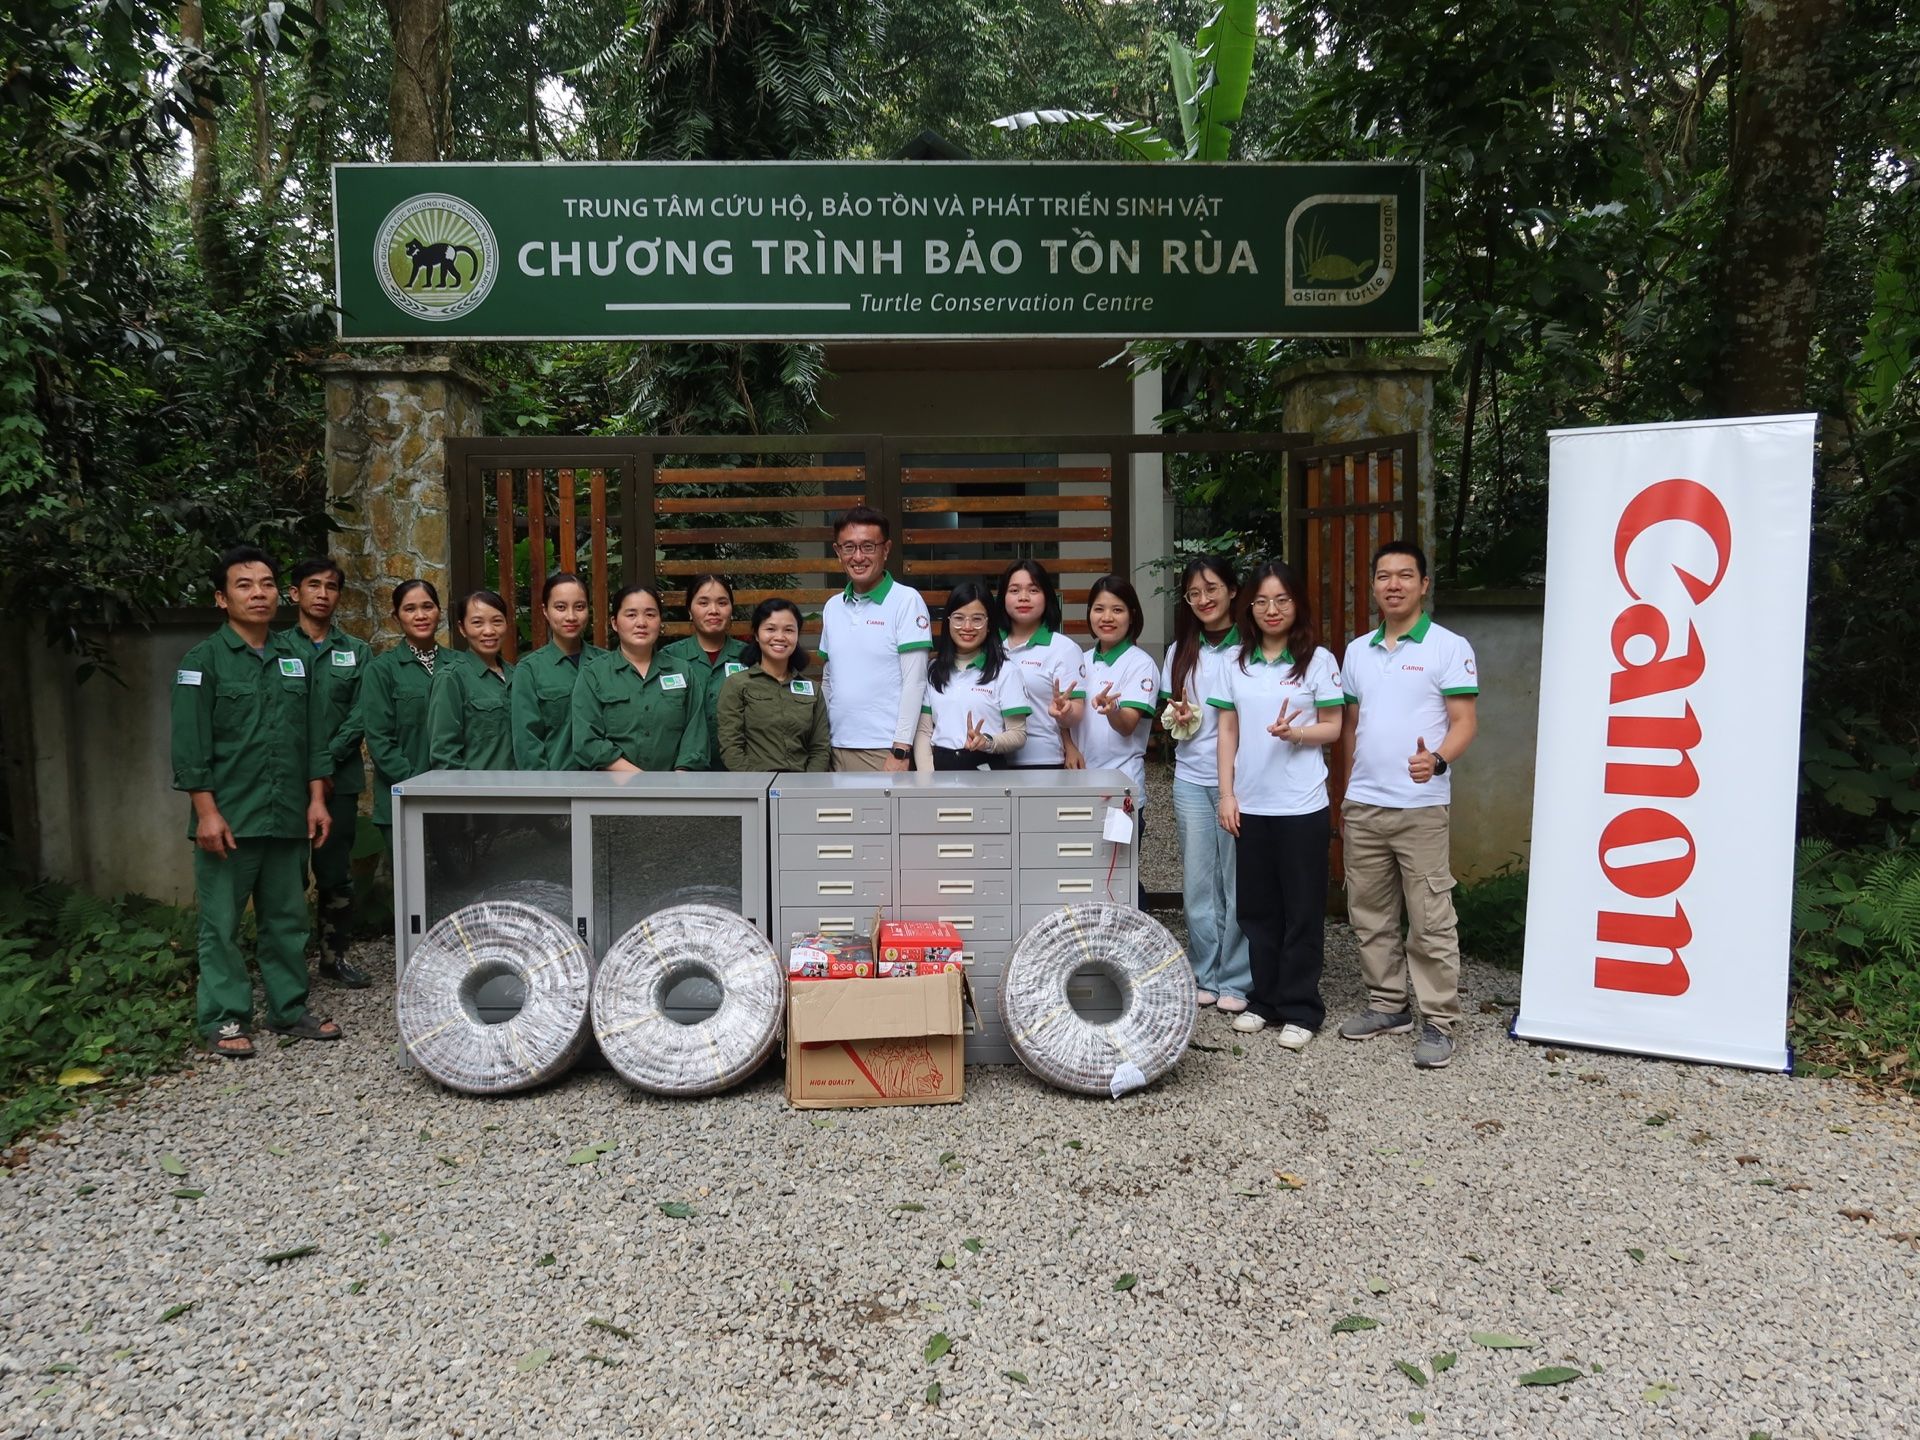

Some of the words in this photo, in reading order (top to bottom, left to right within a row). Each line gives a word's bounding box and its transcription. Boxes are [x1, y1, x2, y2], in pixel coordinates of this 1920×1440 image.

[563, 197, 648, 217] TRUNG
[653, 194, 704, 217] TÂM
[711, 193, 763, 217] CỨU
[772, 194, 814, 222] HỘ,
[823, 191, 873, 217] BẢO
[877, 191, 928, 217] TỒN
[933, 193, 965, 217] VÀ
[972, 193, 1035, 216] PHÁT
[1039, 191, 1109, 216] TRIỂN
[1117, 197, 1173, 217] SINH
[1178, 194, 1223, 221] VẬT
[481, 232, 492, 266] NATIONAL
[518, 234, 733, 277] CHƯƠNG
[752, 229, 903, 275] TRÌNH
[925, 228, 1023, 275] BẢO
[1041, 227, 1140, 275] TỒN
[1163, 229, 1259, 275] RÙA
[1293, 290, 1337, 302] asian
[1345, 277, 1385, 301] turtle
[1382, 204, 1396, 270] program
[480, 268, 492, 289] PARK
[861, 293, 922, 312] Turtle
[931, 293, 1074, 312] Conservation
[1083, 293, 1154, 312] Centre
[1401, 664, 1425, 672] Canon
[1594, 478, 1732, 997] Canon
